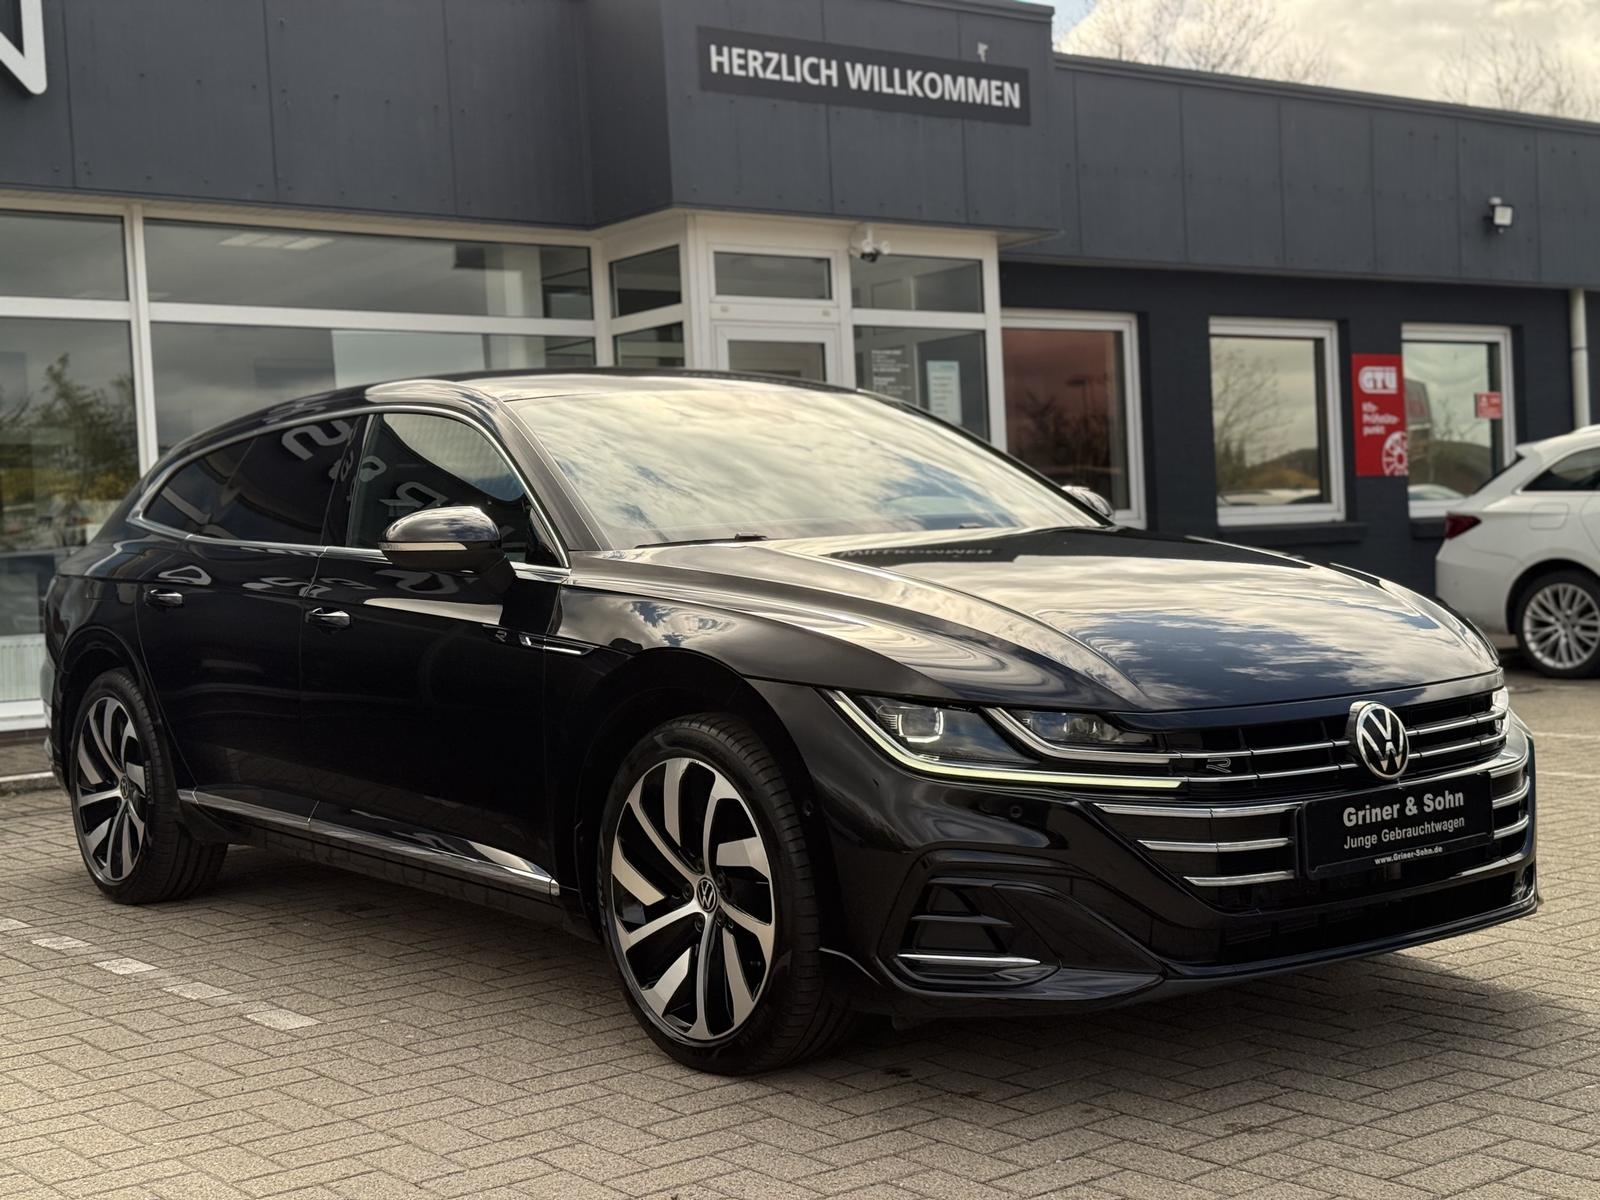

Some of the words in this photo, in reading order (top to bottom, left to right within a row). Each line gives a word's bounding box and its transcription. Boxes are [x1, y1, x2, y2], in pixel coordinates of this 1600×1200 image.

[709, 44, 838, 87] HERZLICH
[845, 61, 1020, 109] WILLKOMMEN
[1343, 803, 1400, 827] Griner
[1405, 796, 1418, 816] &
[1423, 790, 1464, 812] Sohn
[1344, 834, 1377, 850] Junge
[1381, 816, 1465, 842] Gebrauchtwagen
[1374, 845, 1443, 865] www.Griner-Sohn.de
